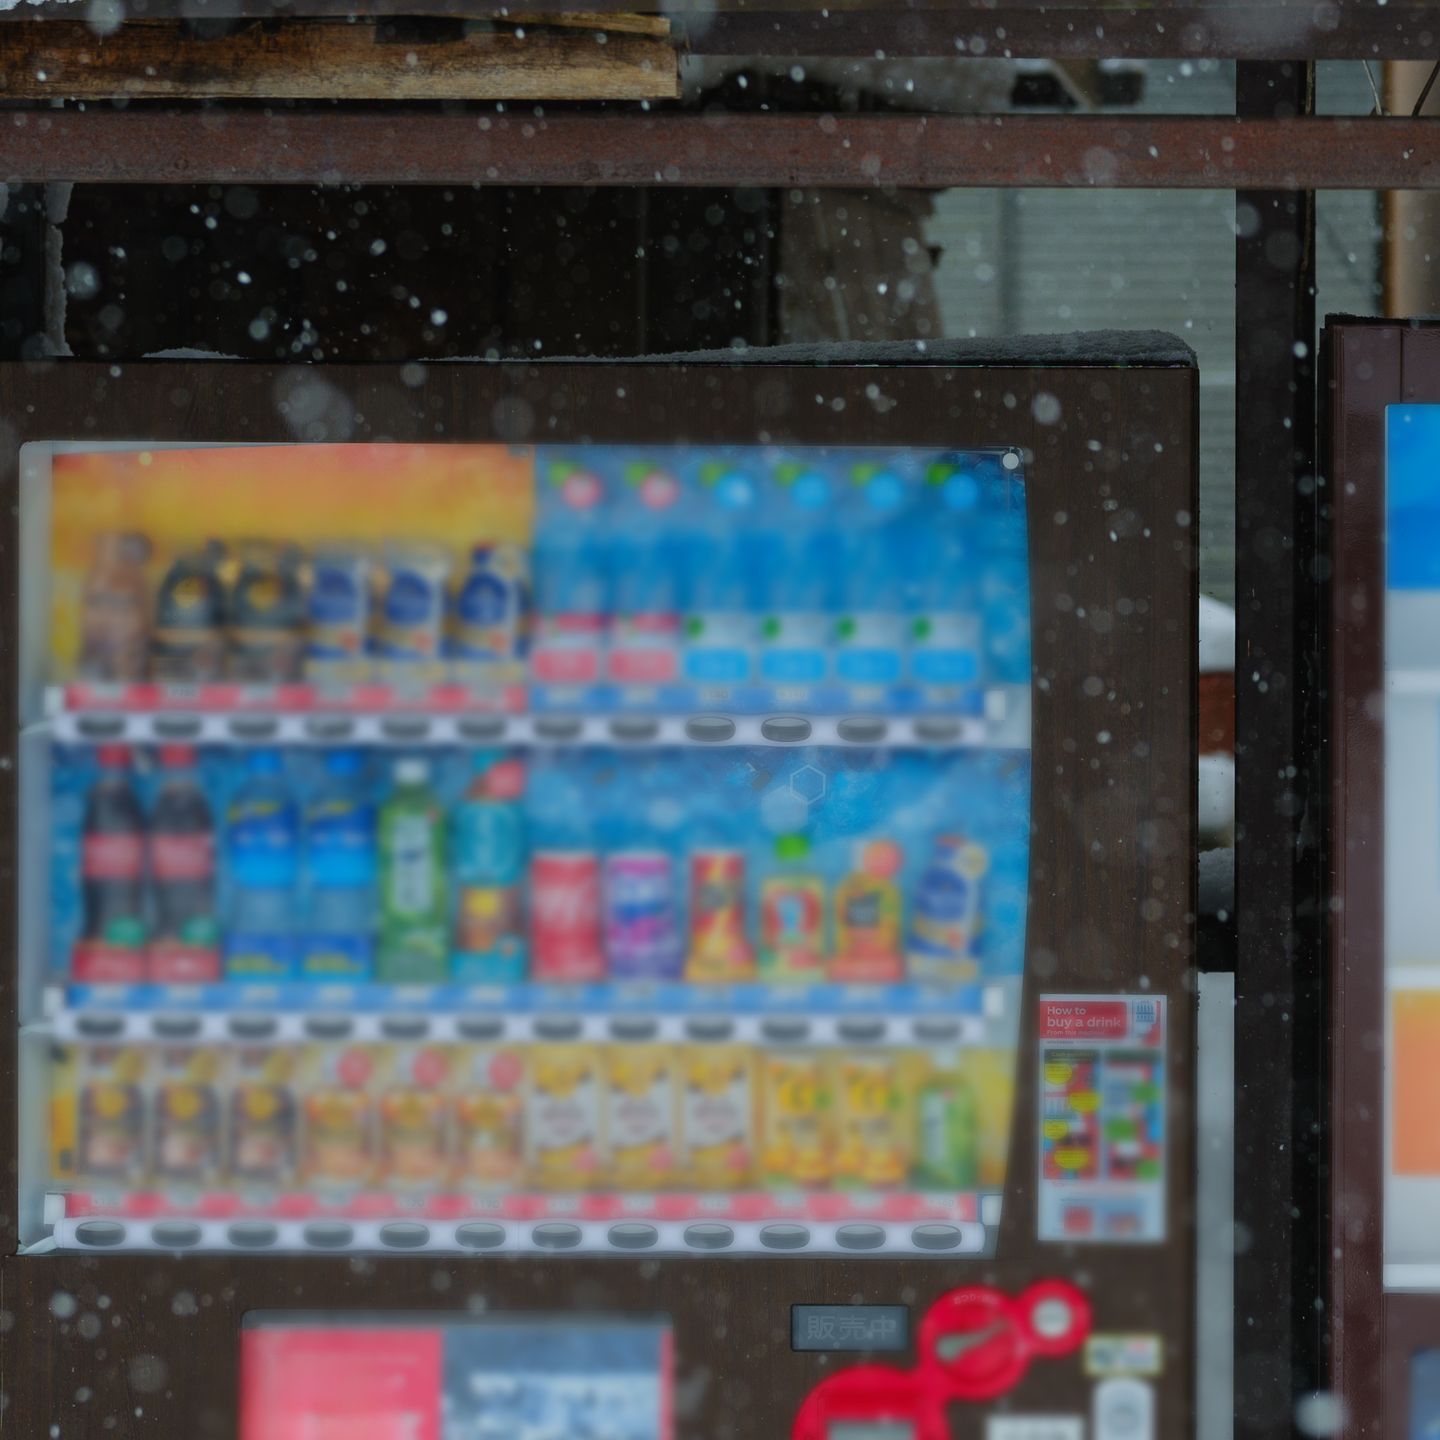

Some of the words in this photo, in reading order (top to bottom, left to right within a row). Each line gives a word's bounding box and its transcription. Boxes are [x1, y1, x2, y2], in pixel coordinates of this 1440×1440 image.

[1047, 1006, 1072, 1015] How
[1075, 1007, 1087, 1016] to
[1047, 1017, 1072, 1029] buy
[1074, 1019, 1084, 1027] a
[1086, 1016, 1121, 1028] drink
[807, 1314, 897, 1341] 販売中
